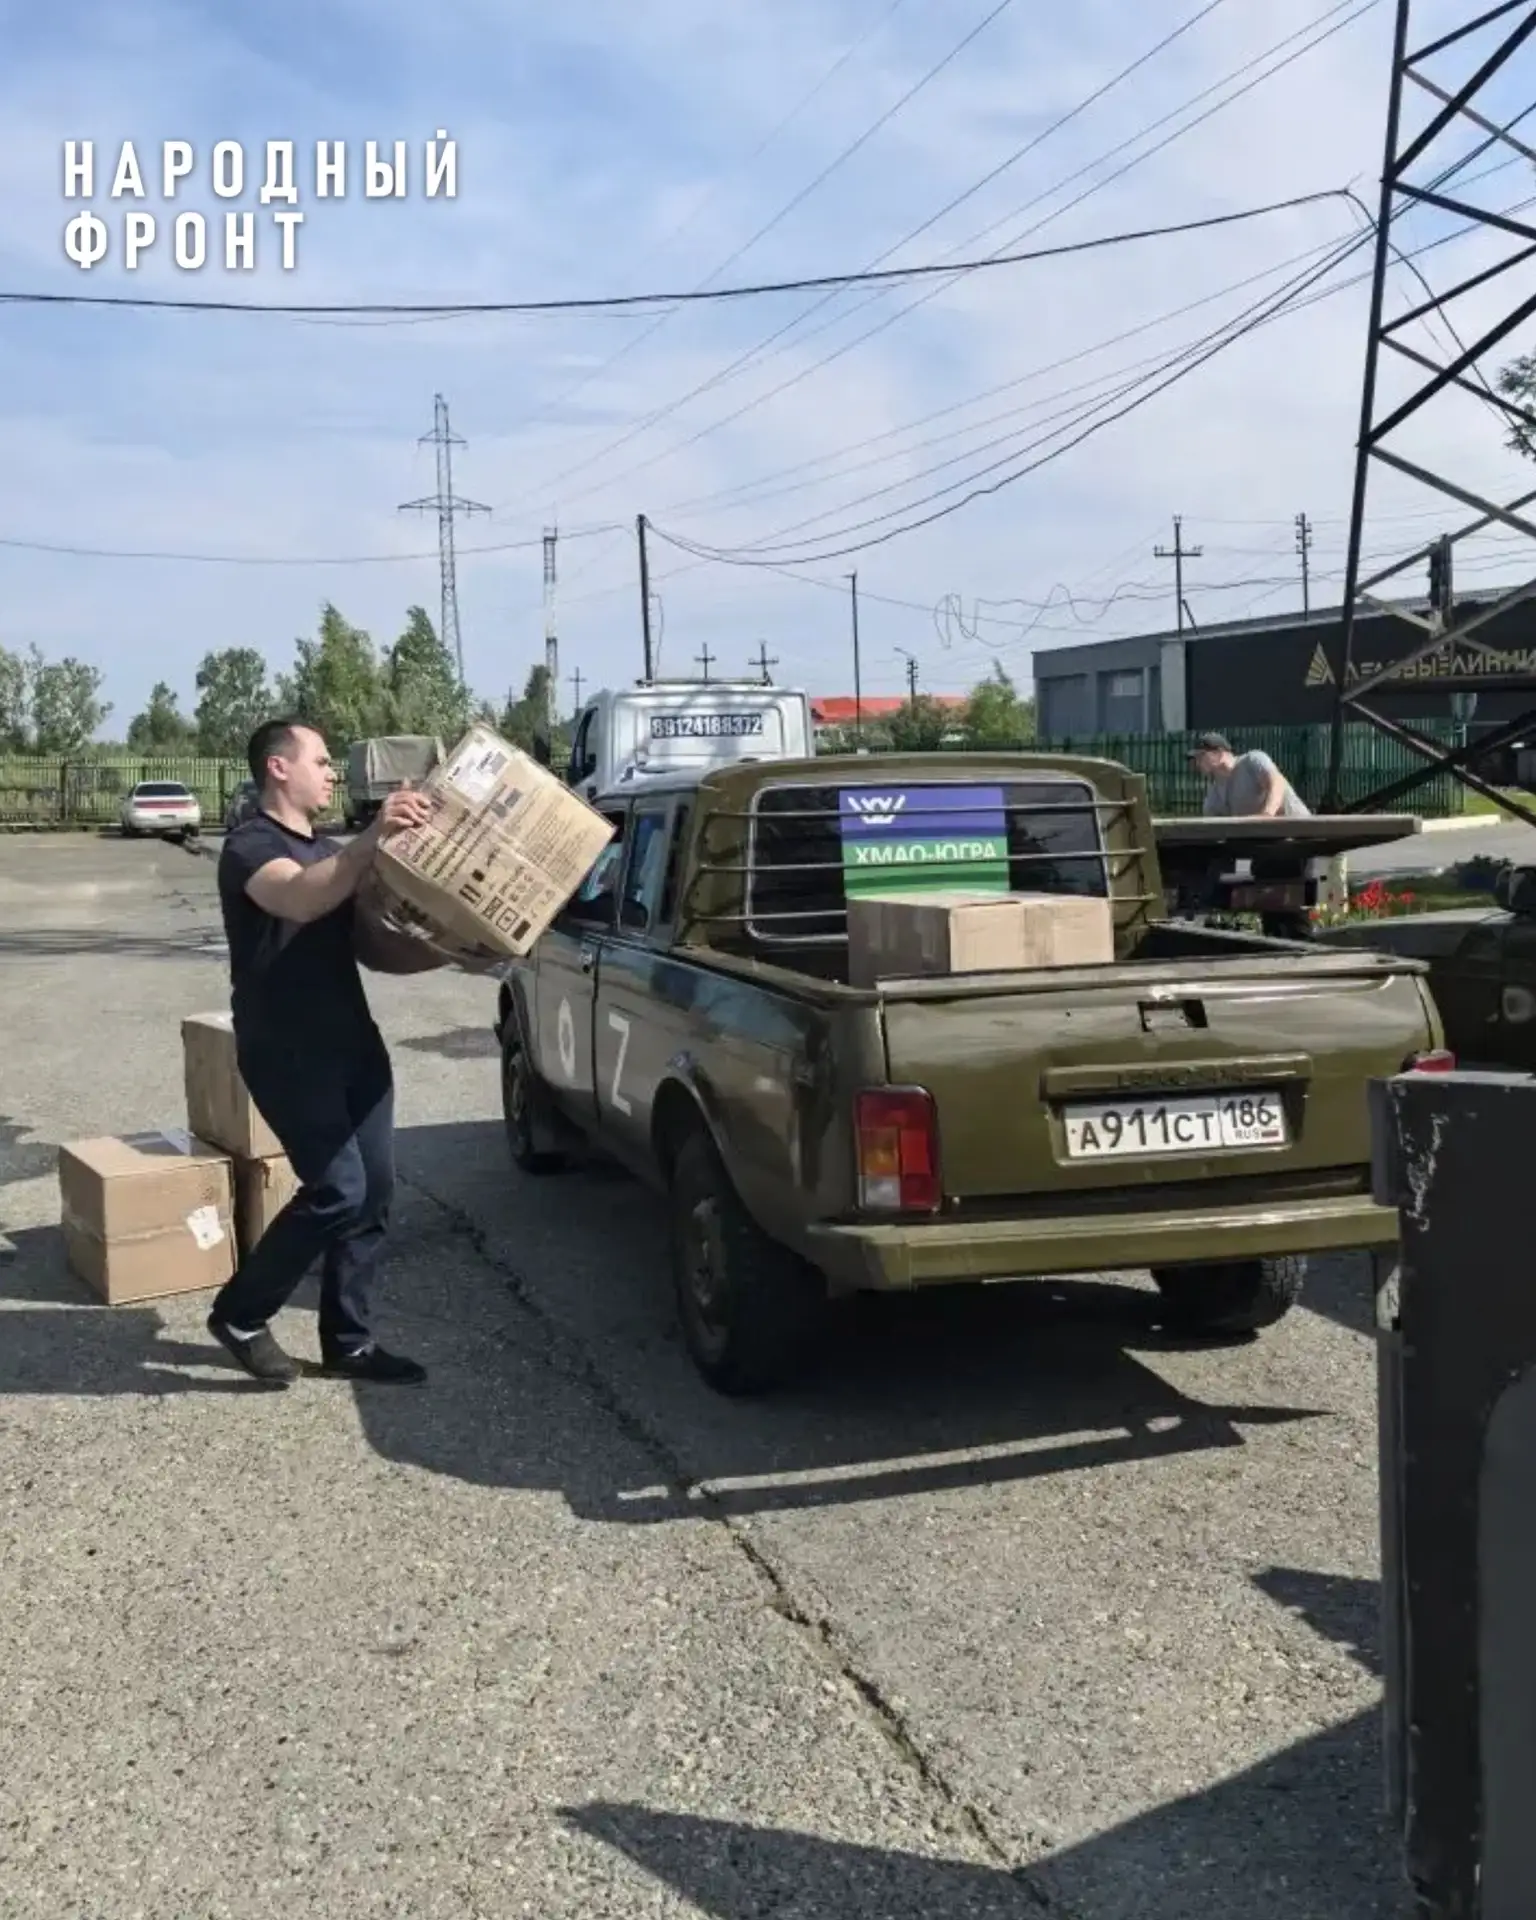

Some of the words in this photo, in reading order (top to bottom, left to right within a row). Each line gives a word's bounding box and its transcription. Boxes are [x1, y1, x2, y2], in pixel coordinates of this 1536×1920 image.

[855, 840, 997, 865] ХМАО-ЮГРА
[608, 1011, 632, 1117] Z
[1079, 1106, 1215, 1151] А911СТ
[1222, 1097, 1272, 1129] 186
